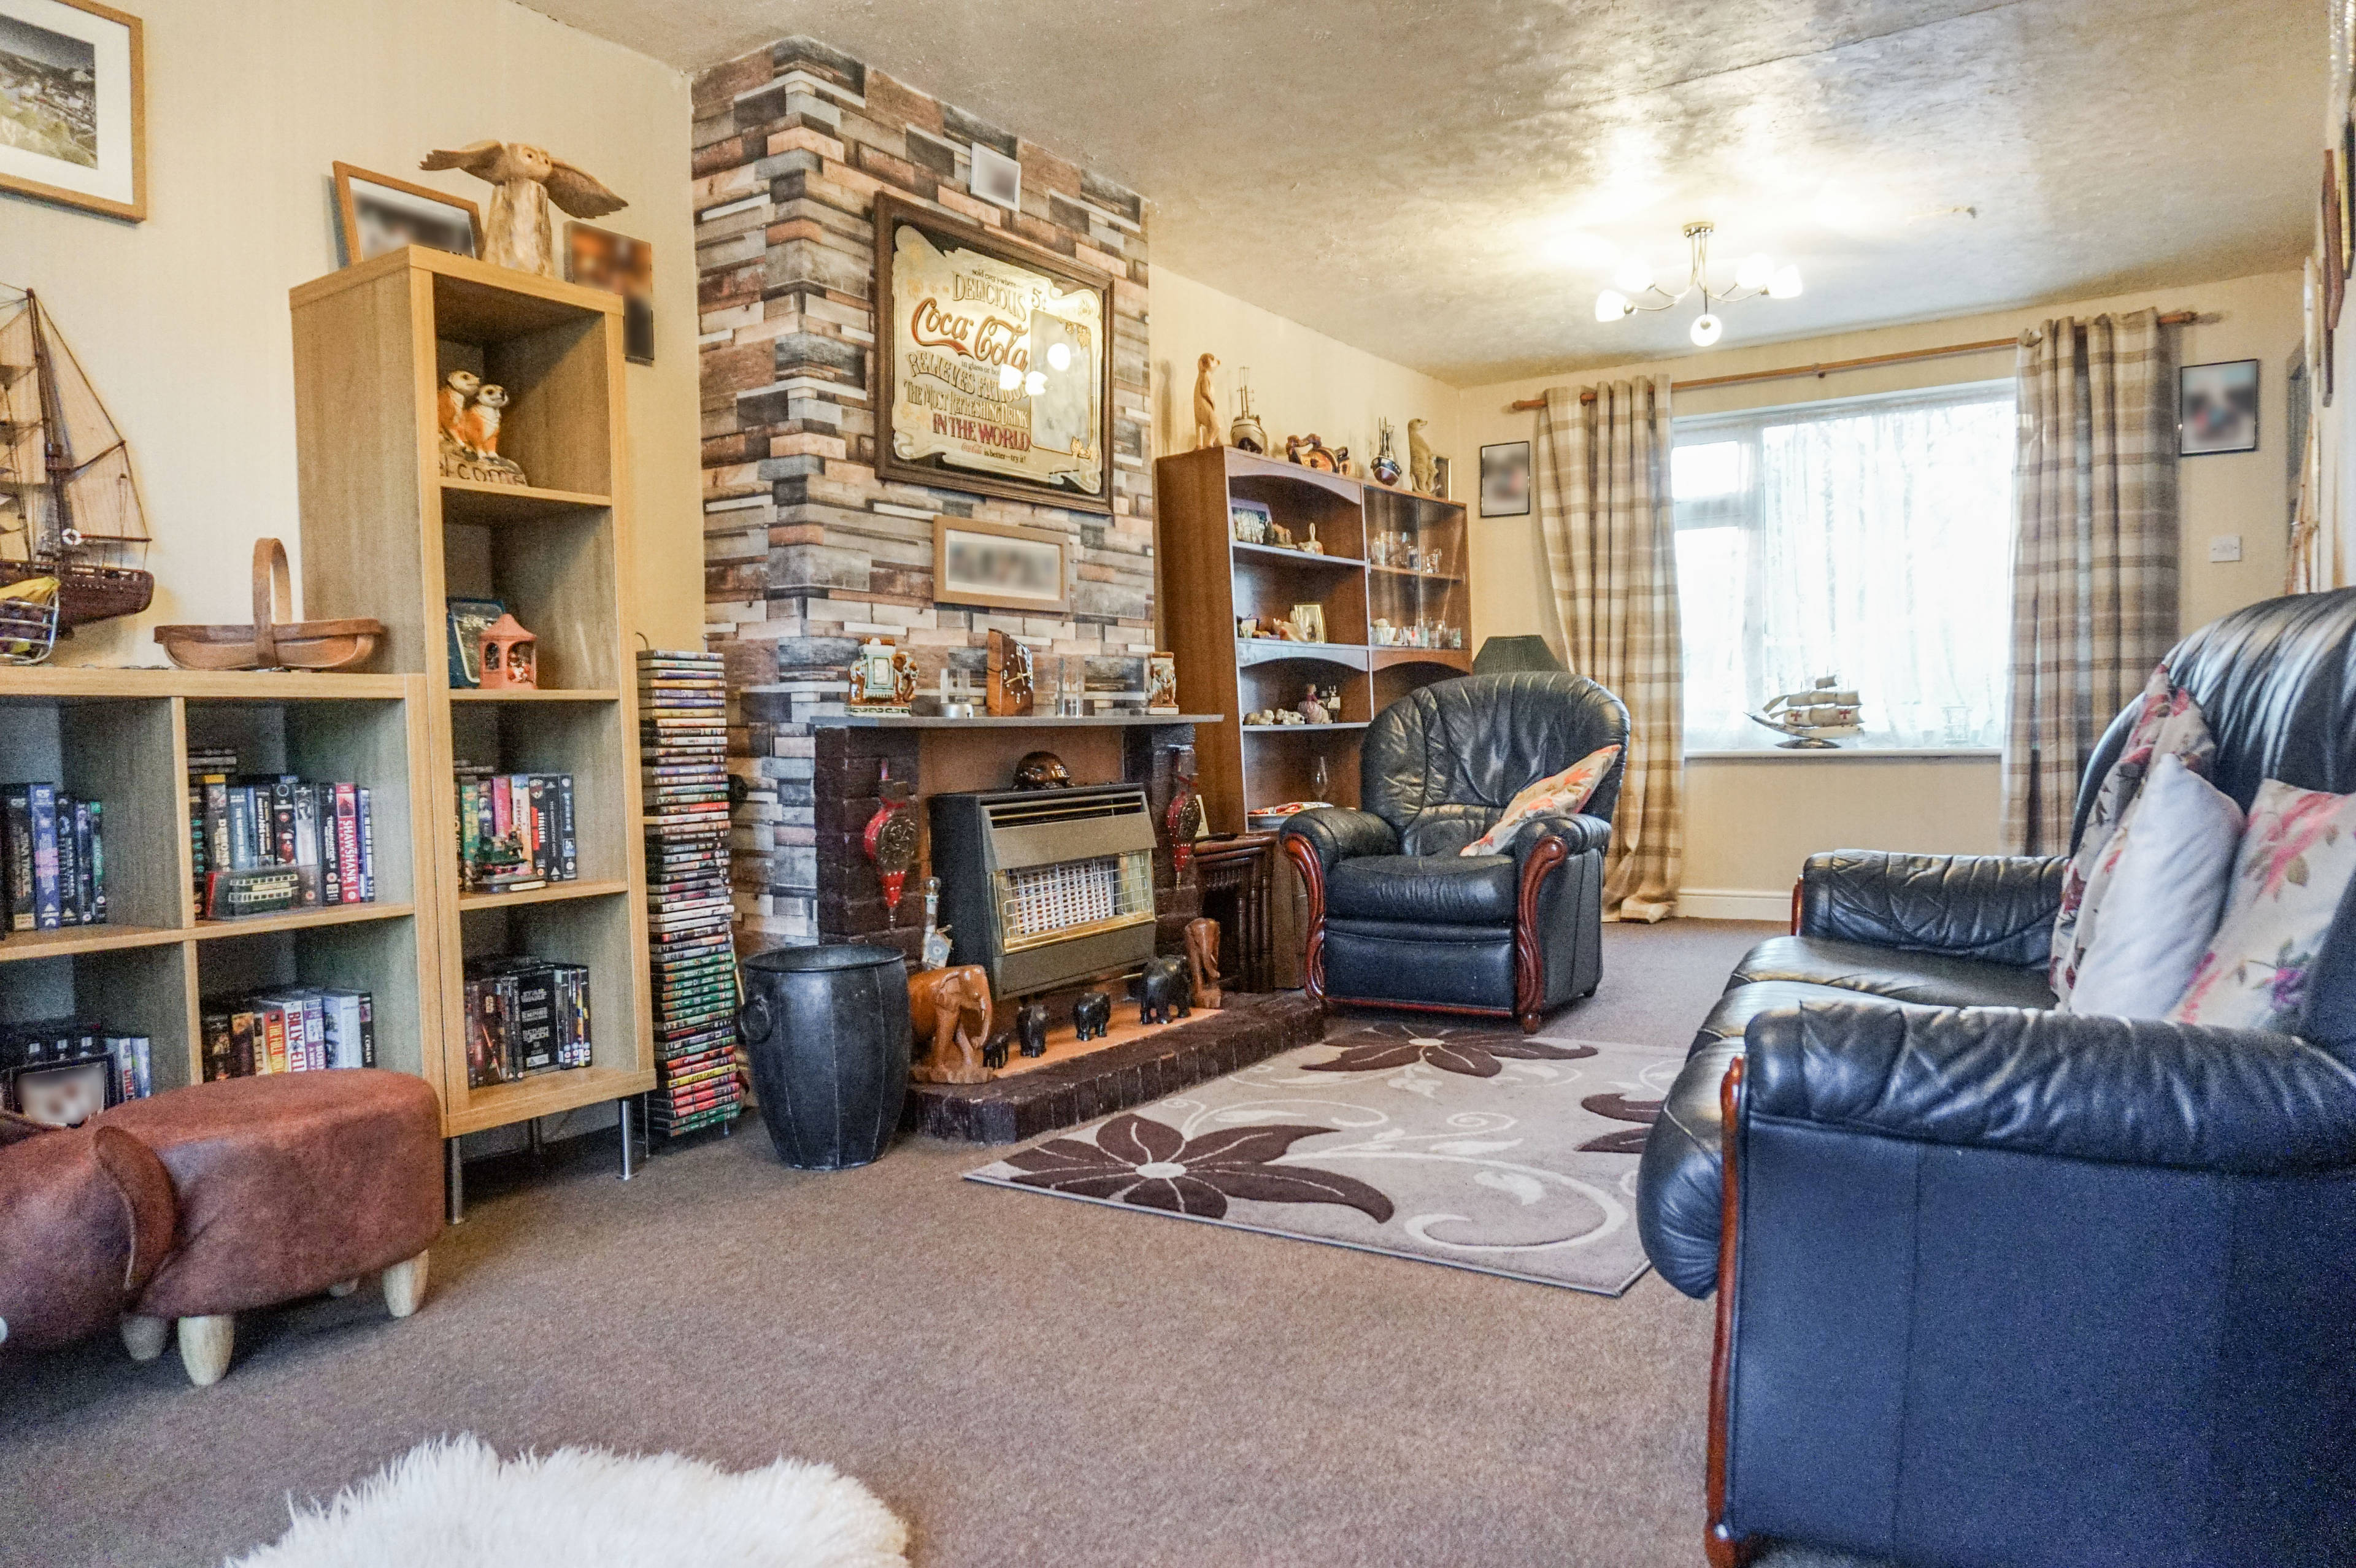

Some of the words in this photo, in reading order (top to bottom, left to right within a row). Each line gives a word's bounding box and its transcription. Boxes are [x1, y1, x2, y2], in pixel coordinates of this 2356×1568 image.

[952, 271, 1026, 322] DELICIOUS
[905, 350, 976, 394] RELIEVES
[961, 359, 968, 367] in
[968, 361, 983, 372] glass
[904, 379, 922, 405] THE
[923, 383, 949, 411] MOST
[949, 390, 1001, 422] REFRESHING
[1001, 402, 1028, 429] DRINK
[933, 413, 947, 435] IN
[949, 416, 977, 442] THE
[326, 815, 336, 861] TERMINATOR
[343, 820, 357, 883] SHAWSHANK
[269, 1024, 283, 1037] THE
[287, 1012, 303, 1041] BILLY
[253, 1039, 264, 1072] TITA
[270, 1037, 284, 1053] FULL
[271, 1053, 286, 1073] MONT
[290, 1051, 305, 1072] ELL
[688, 1074, 704, 1082] LAYER
